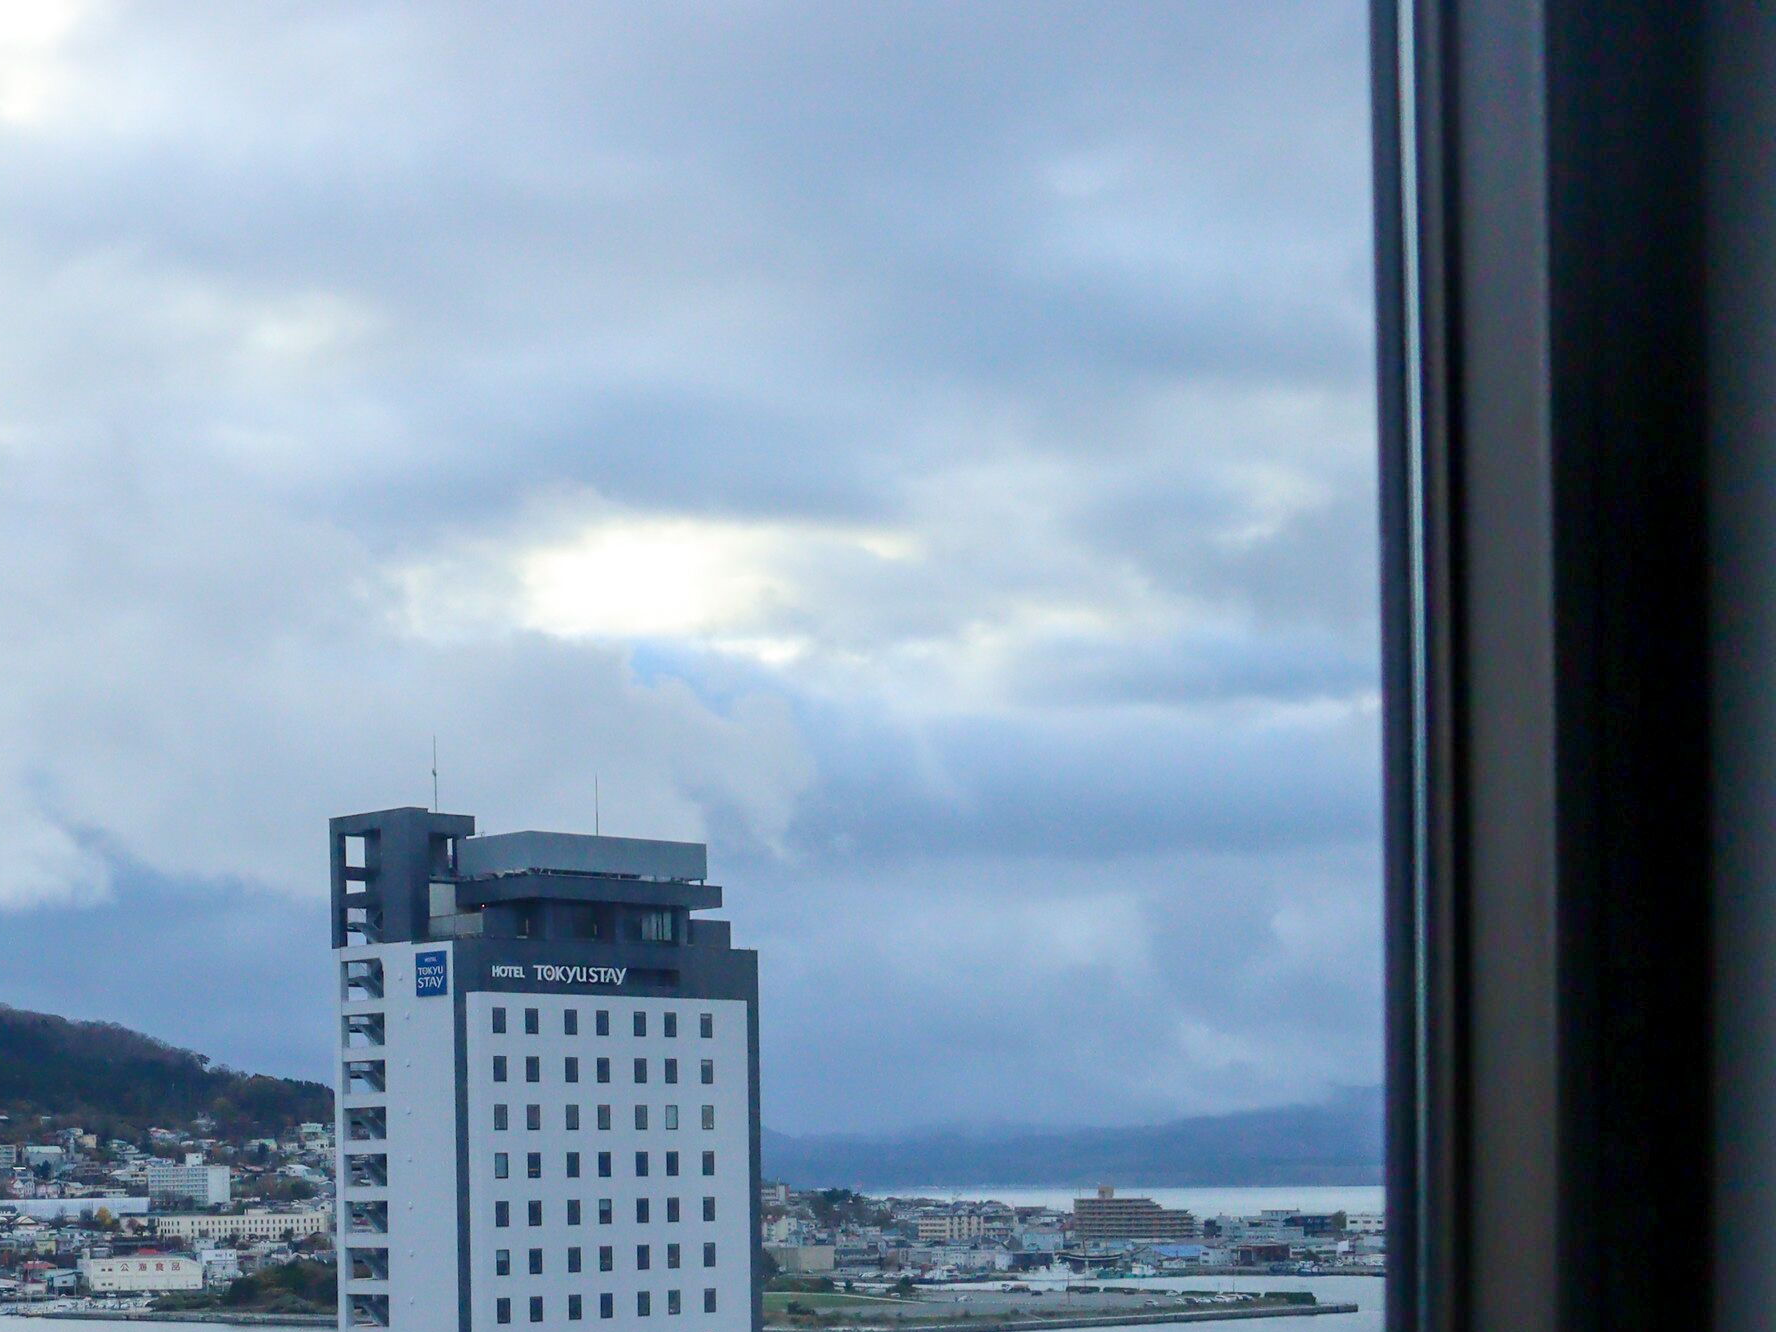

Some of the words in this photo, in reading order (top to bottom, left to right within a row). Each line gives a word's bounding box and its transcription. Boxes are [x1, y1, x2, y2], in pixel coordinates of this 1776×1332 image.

[417, 965, 444, 976] TOKYU
[491, 964, 525, 979] HOTEL
[417, 976, 444, 988] STAY
